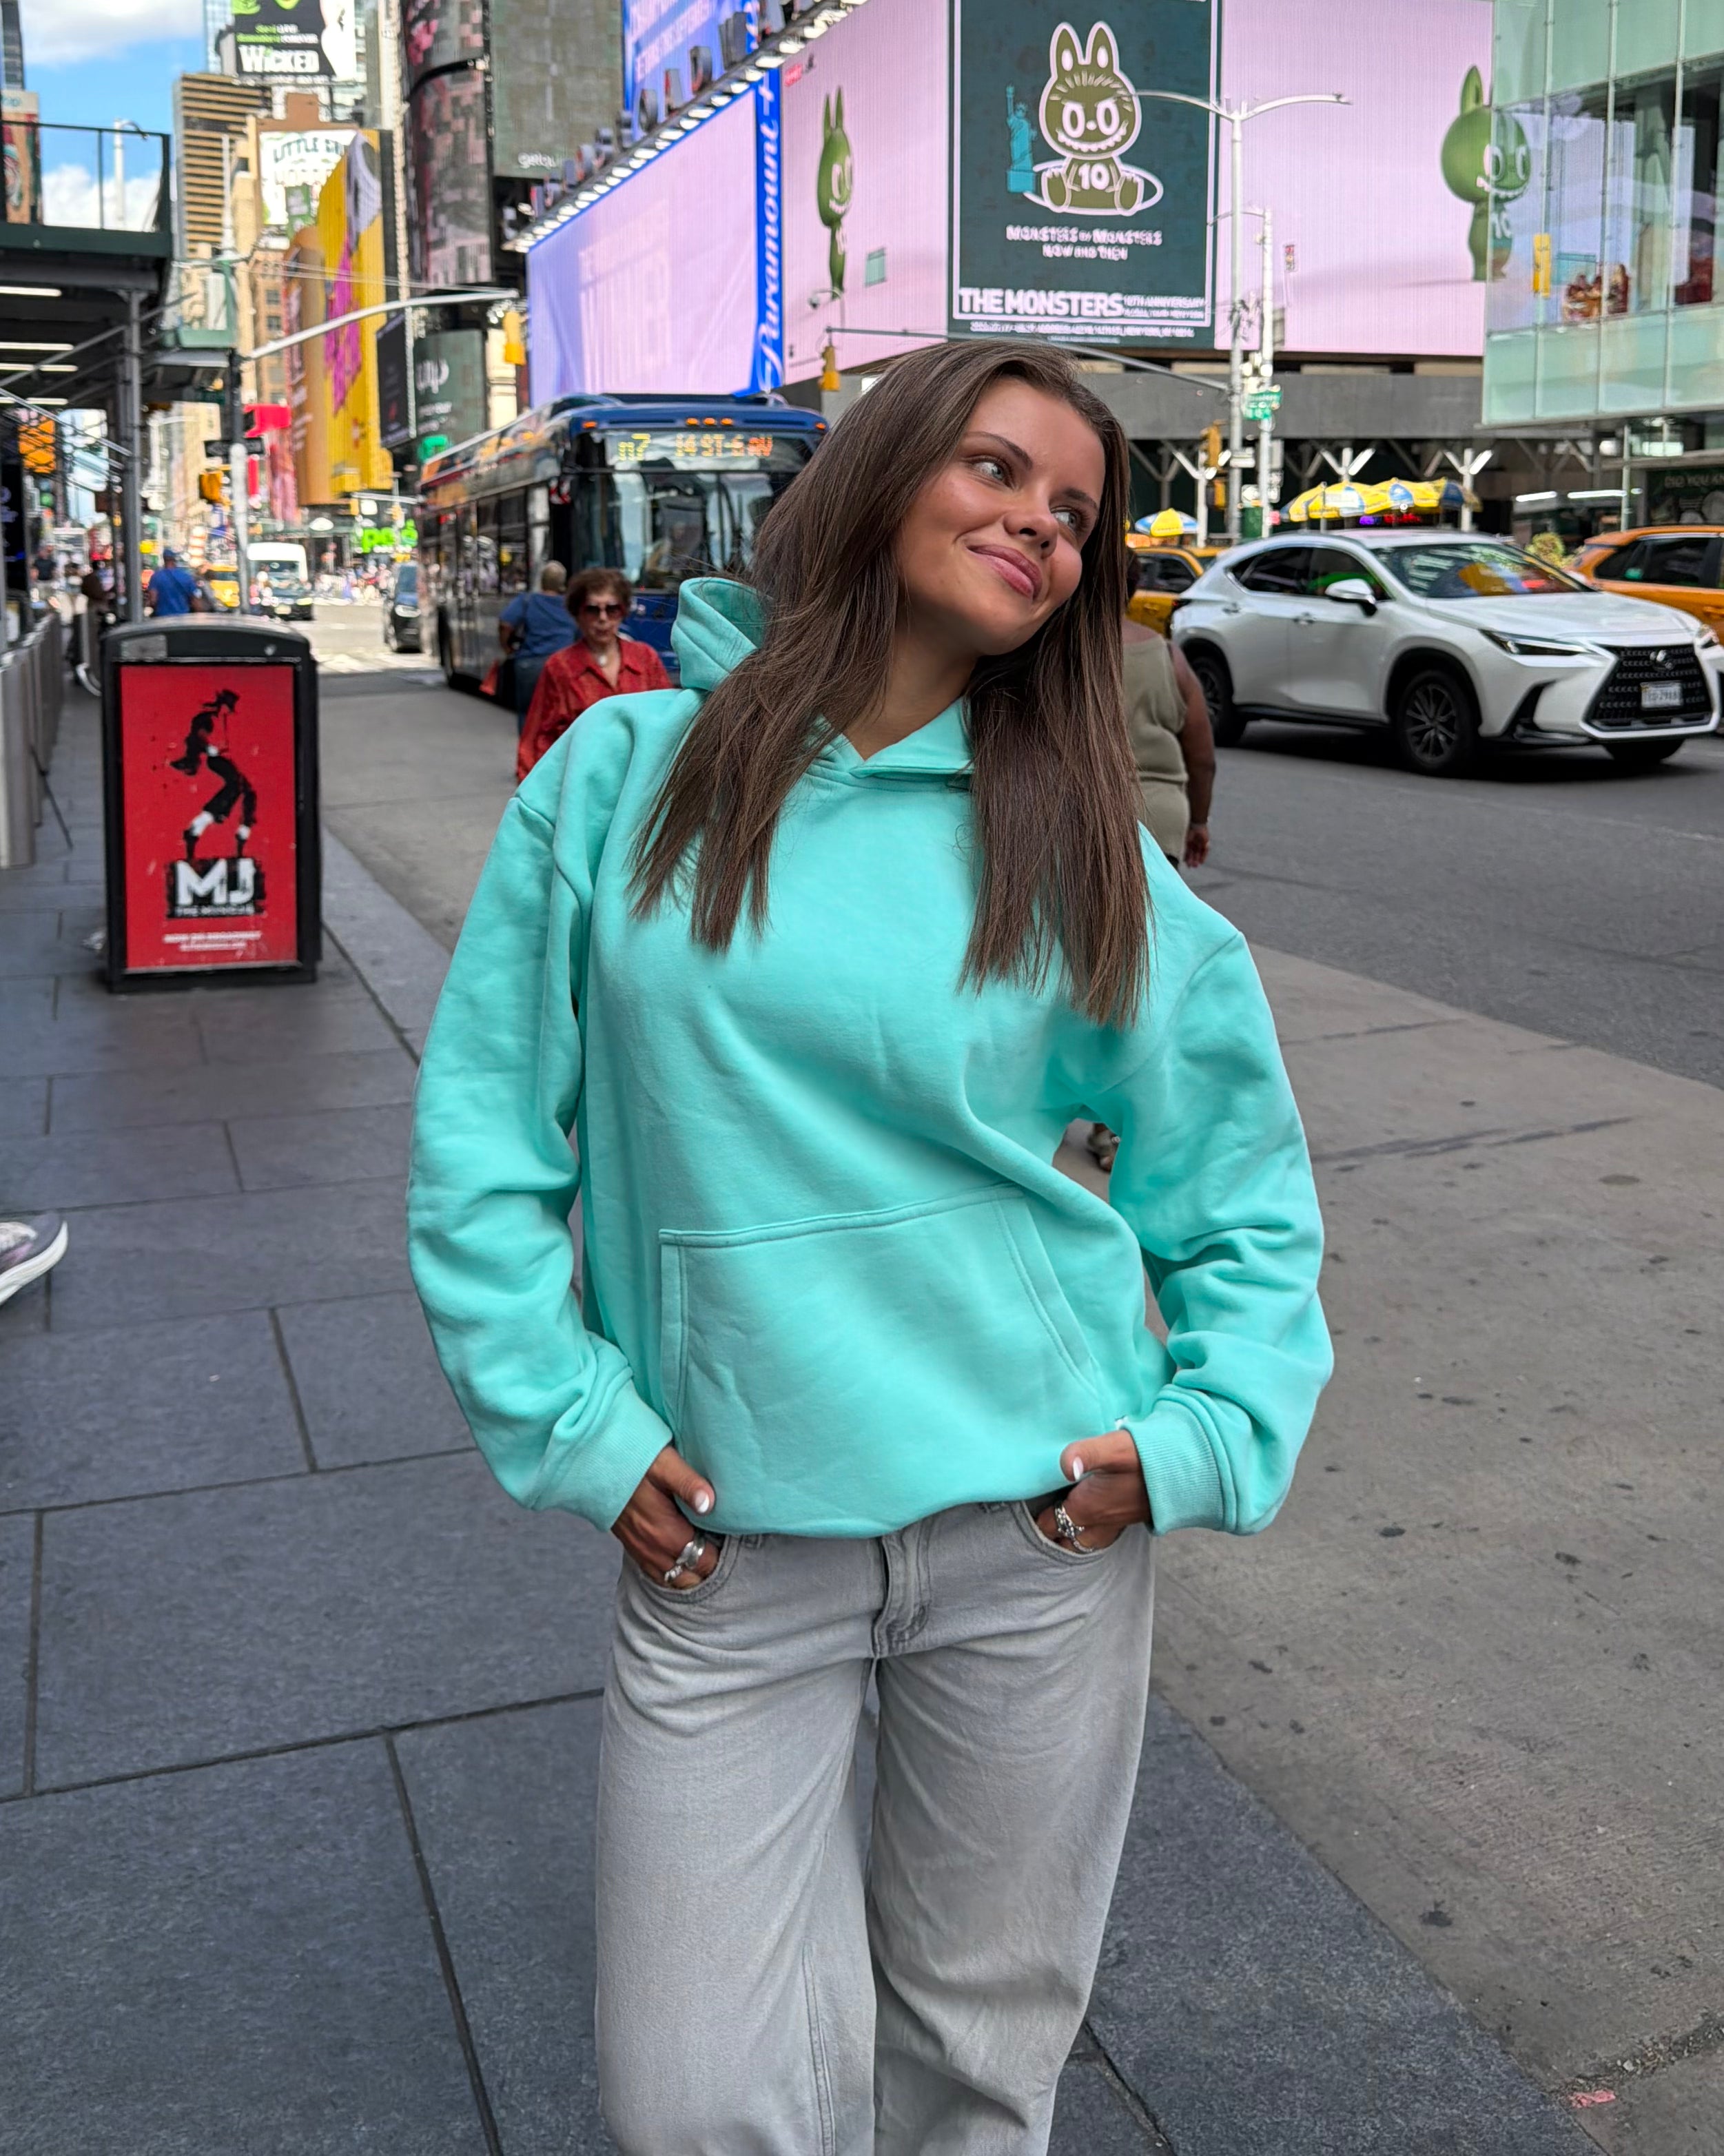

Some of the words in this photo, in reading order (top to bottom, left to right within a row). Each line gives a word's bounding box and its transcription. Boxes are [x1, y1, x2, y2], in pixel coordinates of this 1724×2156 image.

[1078, 163, 1110, 190] 10
[1006, 225, 1078, 242] MONSTERS
[1092, 228, 1163, 246] MONSTERS
[1042, 244, 1074, 258] NOW
[1097, 245, 1128, 260] THEN
[959, 287, 1003, 314] THE
[1004, 289, 1123, 318] MONSTERS
[176, 857, 256, 906] MJ
